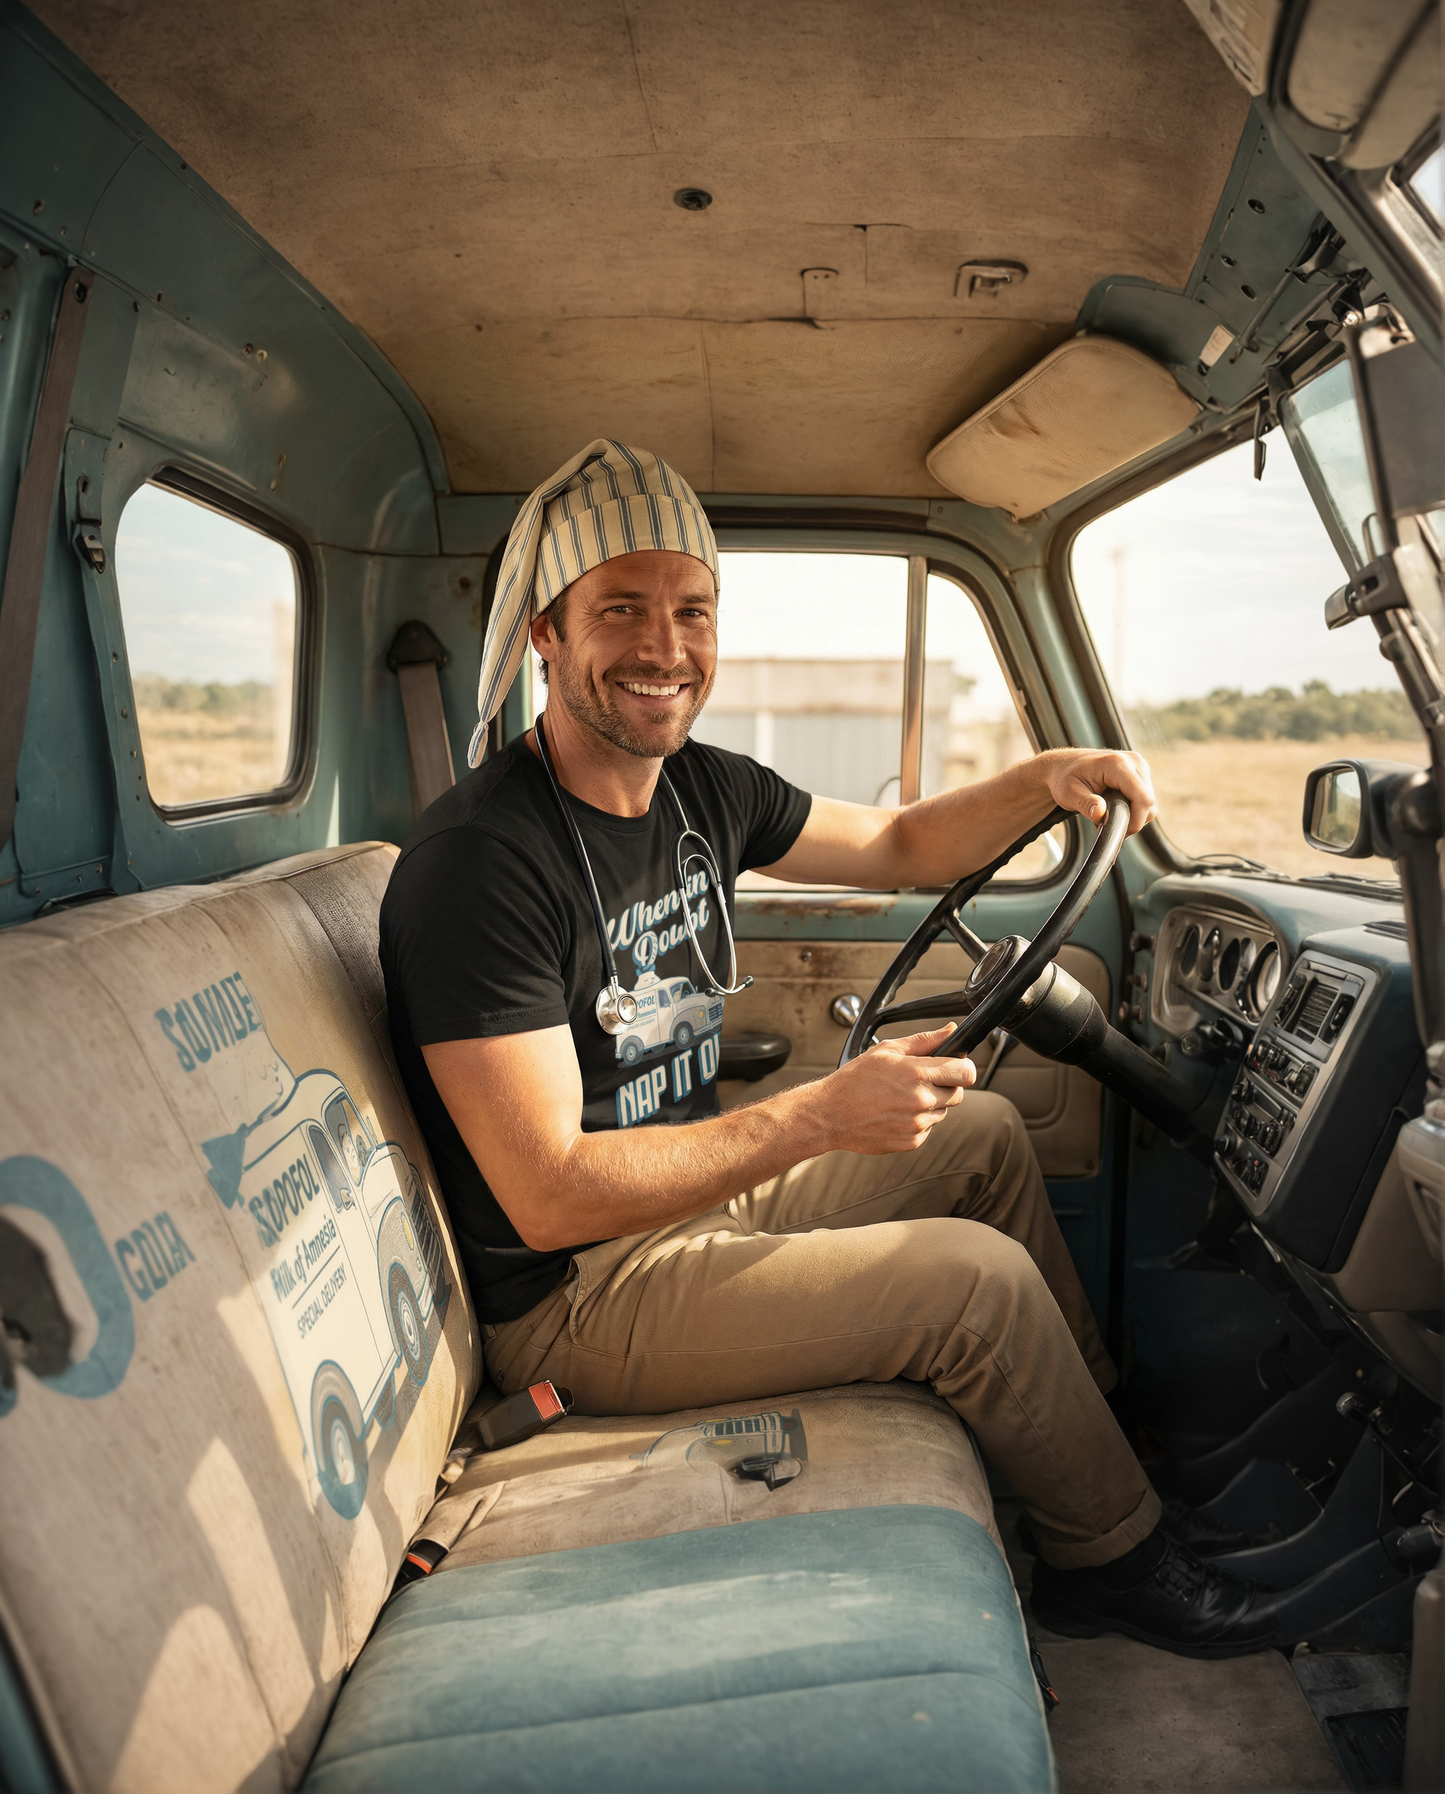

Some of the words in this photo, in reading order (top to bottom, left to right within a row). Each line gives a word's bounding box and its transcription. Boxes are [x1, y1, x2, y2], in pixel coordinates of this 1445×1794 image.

[606, 889, 682, 952] When
[686, 870, 710, 901] in
[615, 1064, 667, 1129] NAP
[671, 1047, 693, 1104] IT
[293, 1244, 308, 1284] of
[301, 1213, 338, 1271] Amnesia
[297, 1295, 325, 1340] SPECIAL
